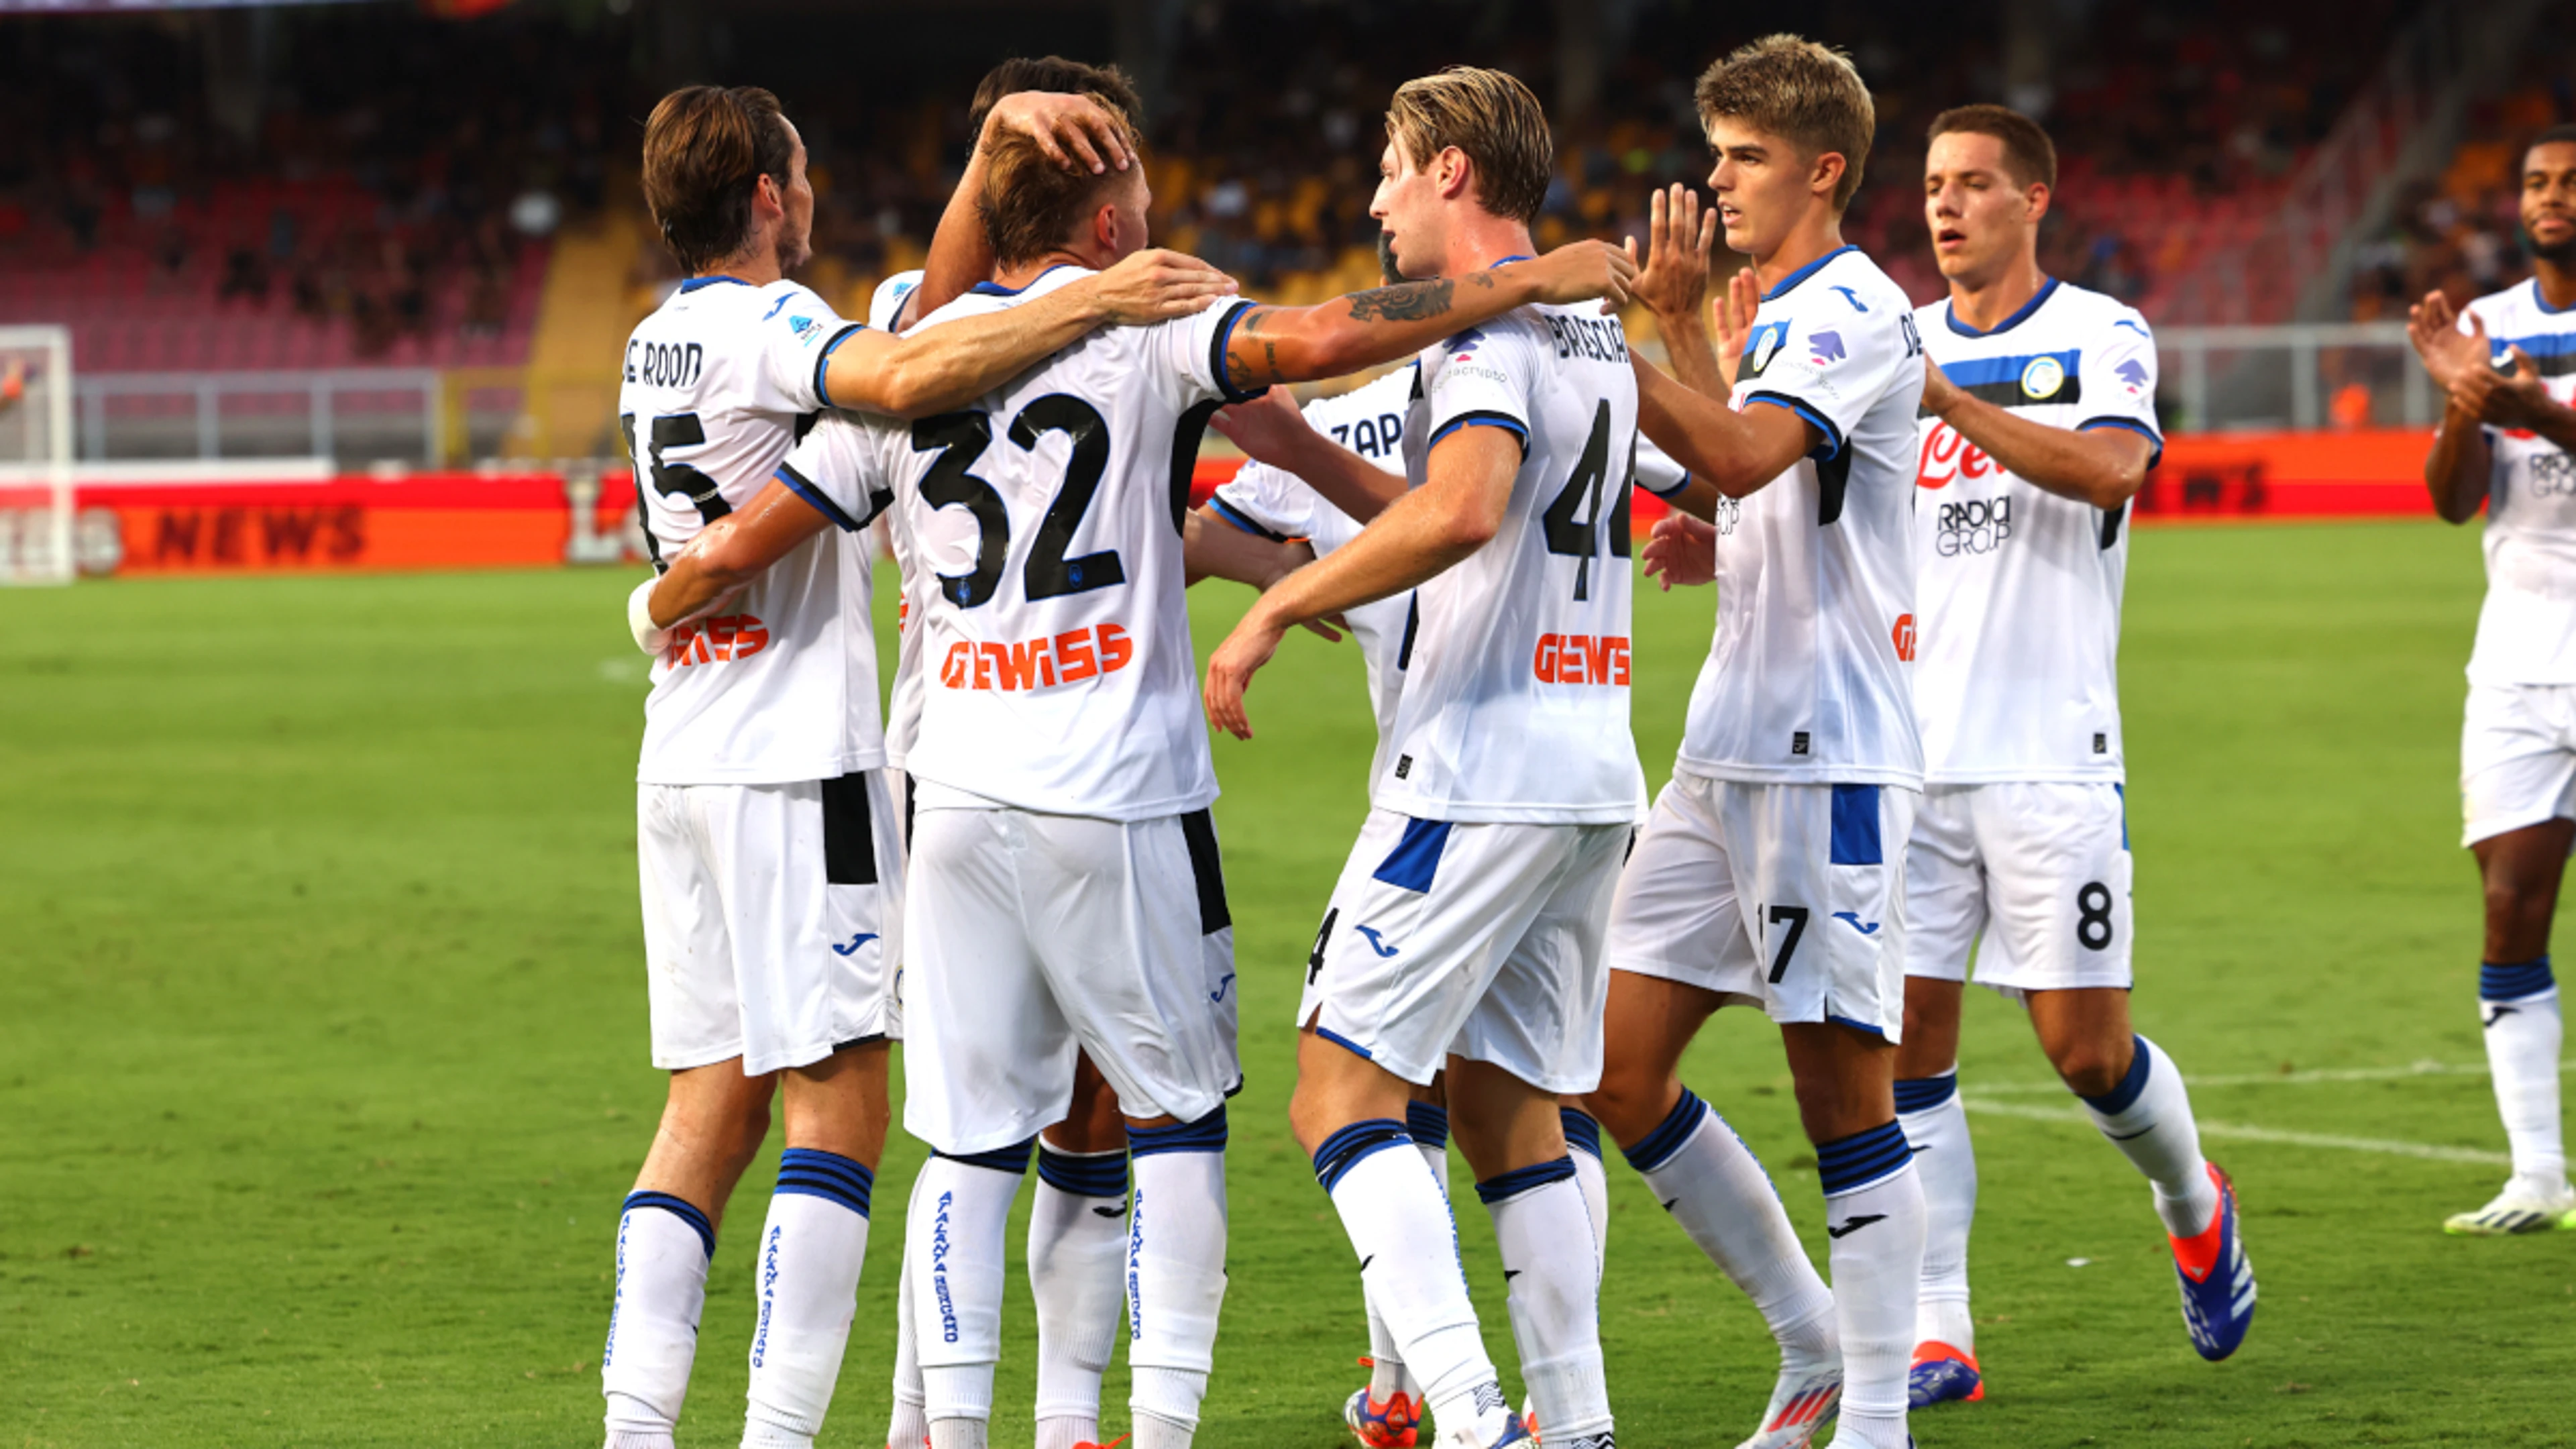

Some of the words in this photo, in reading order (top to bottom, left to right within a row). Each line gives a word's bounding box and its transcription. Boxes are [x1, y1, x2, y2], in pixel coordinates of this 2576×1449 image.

[623, 339, 638, 383] E
[1331, 409, 1409, 458] ZAP
[1915, 420, 2007, 490] Le
[911, 392, 1126, 610] 32
[154, 504, 366, 564] NEWS
[1936, 523, 2012, 557] GROUP
[2076, 881, 2113, 951] 8
